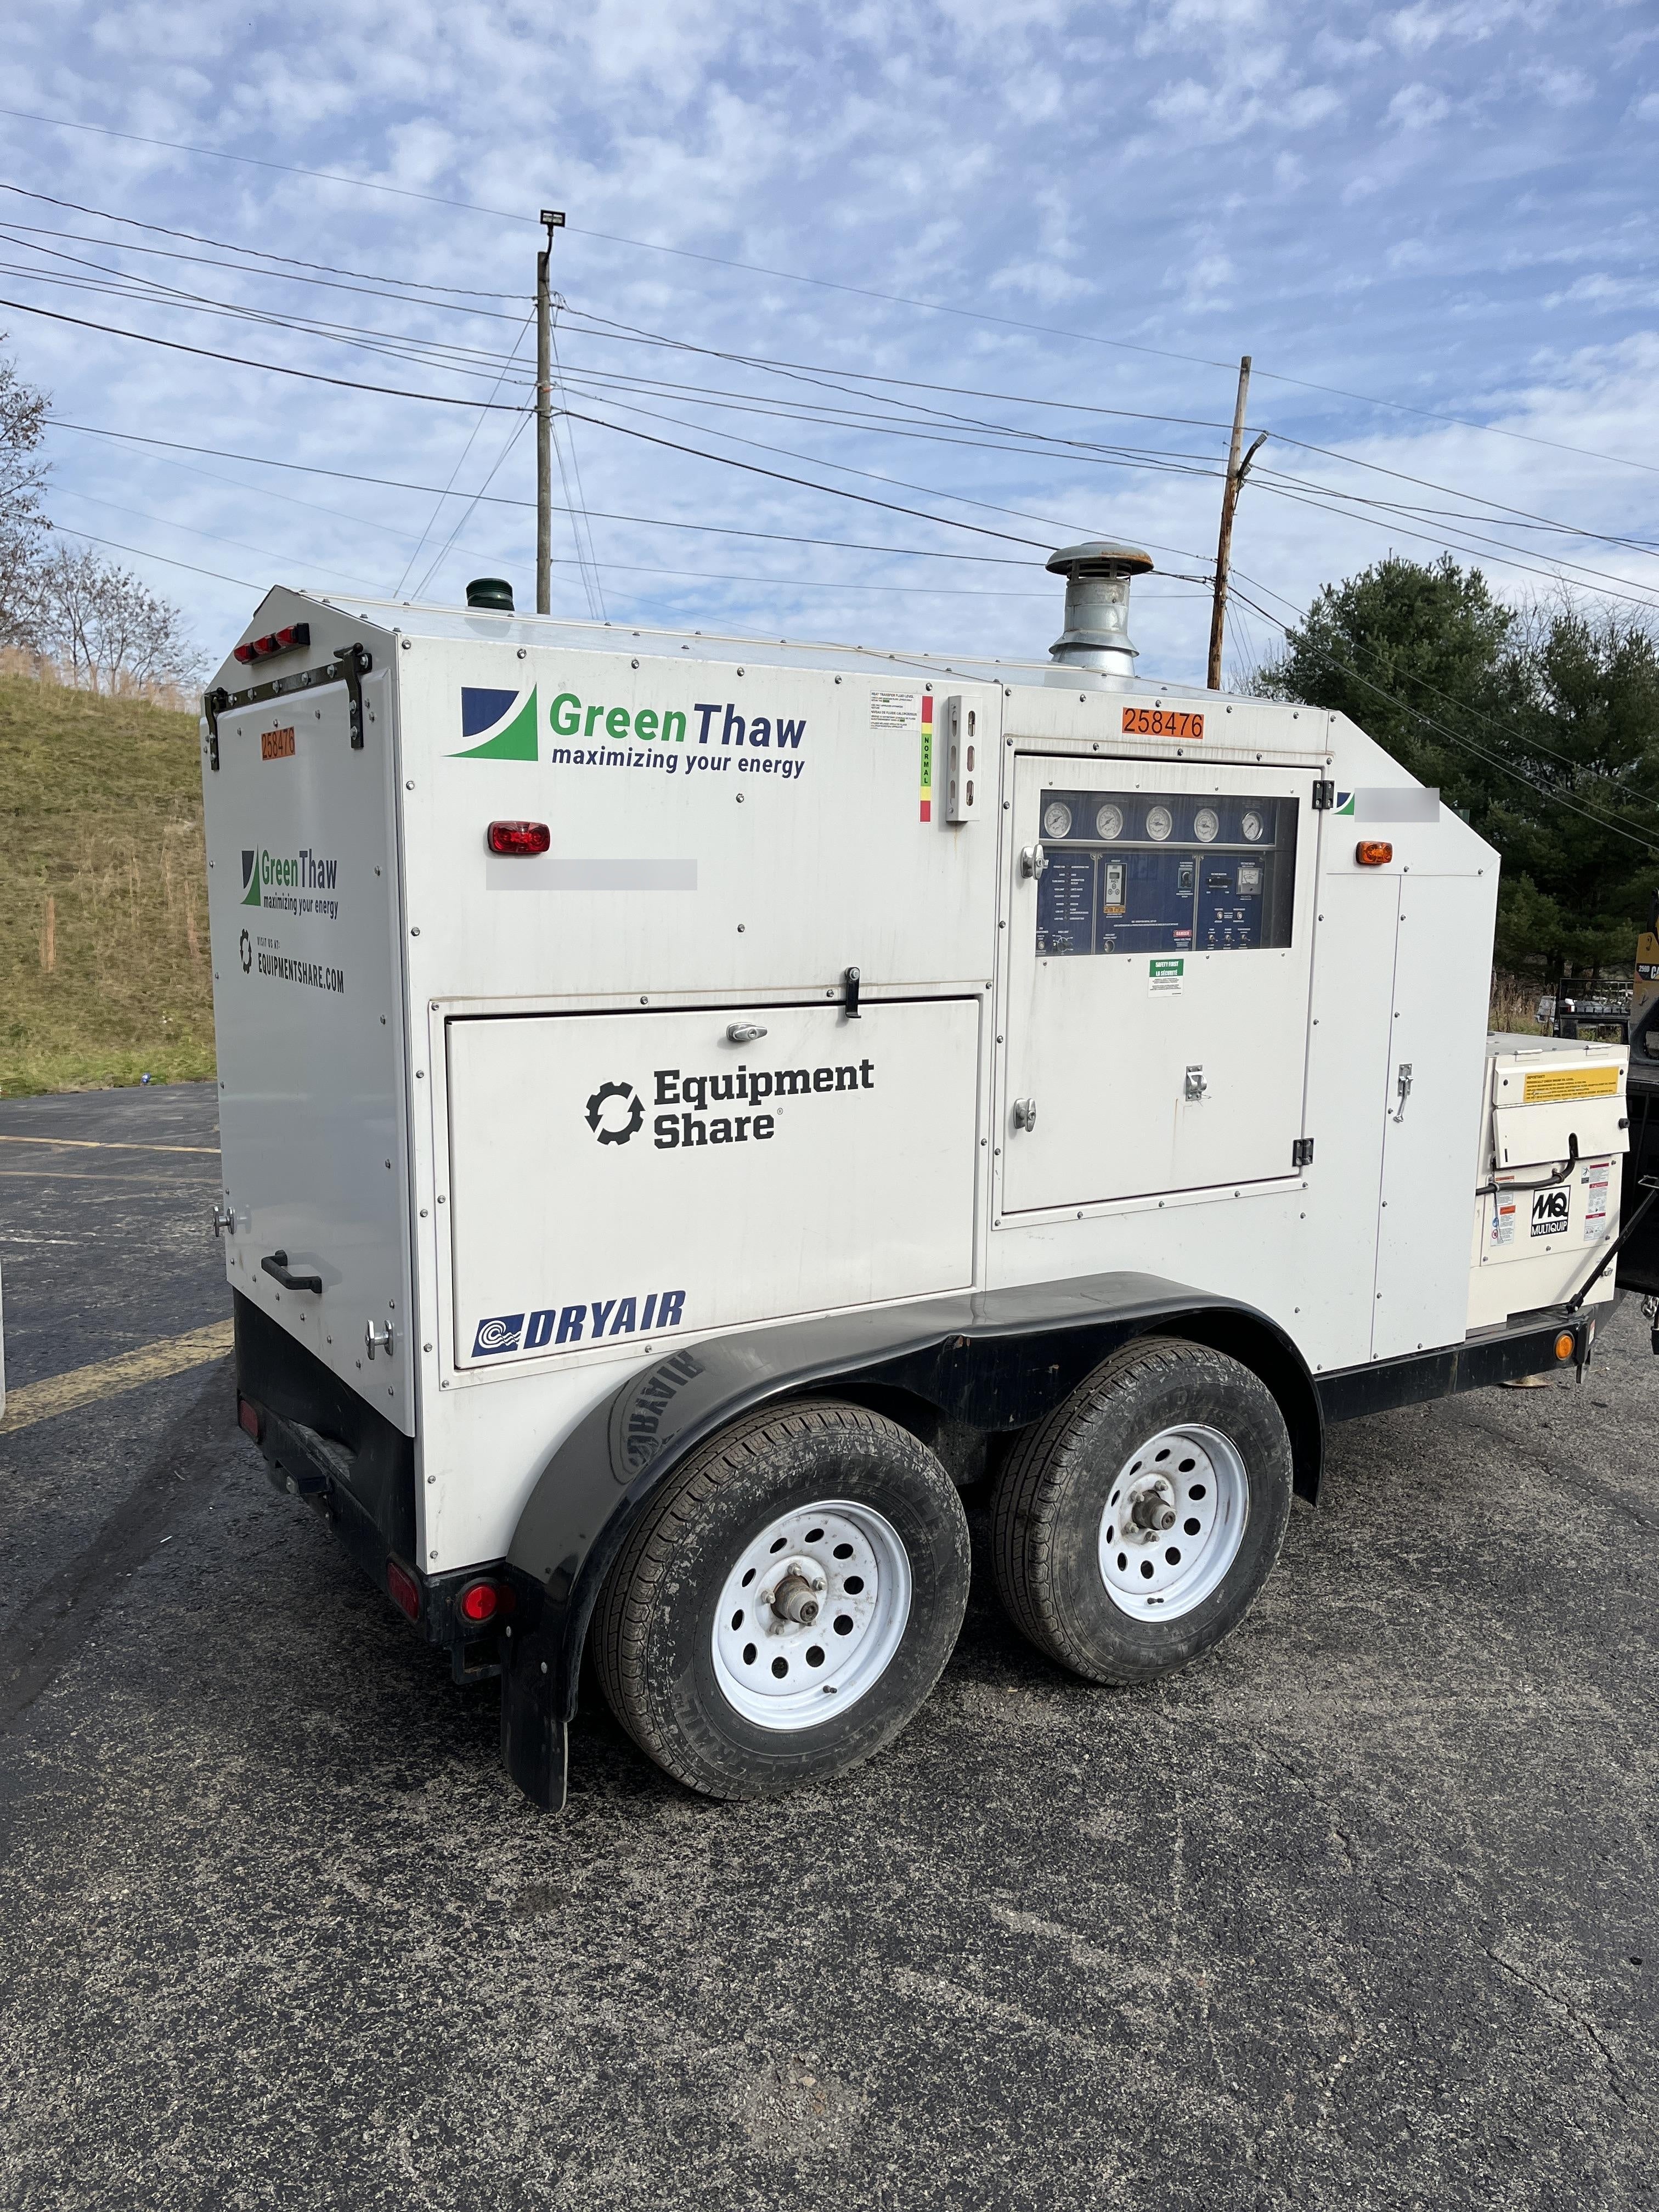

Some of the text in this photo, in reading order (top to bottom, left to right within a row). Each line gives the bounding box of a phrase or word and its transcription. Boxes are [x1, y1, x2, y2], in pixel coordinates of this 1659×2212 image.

[1124, 708, 1203, 737] 258476
[261, 727, 295, 759] 258476
[551, 746, 805, 779] maximizing your energy
[263, 892, 338, 920] maximizing your energy
[257, 936, 267, 947] VISIT
[268, 938, 273, 949] US
[258, 952, 344, 994] EQUIPMENTSHARE.COM
[653, 1058, 874, 1111] Equipment
[1533, 1192, 1568, 1219] MQ
[1532, 1220, 1567, 1236] MULTIQUIP
[522, 1290, 686, 1350] DRYAIR
